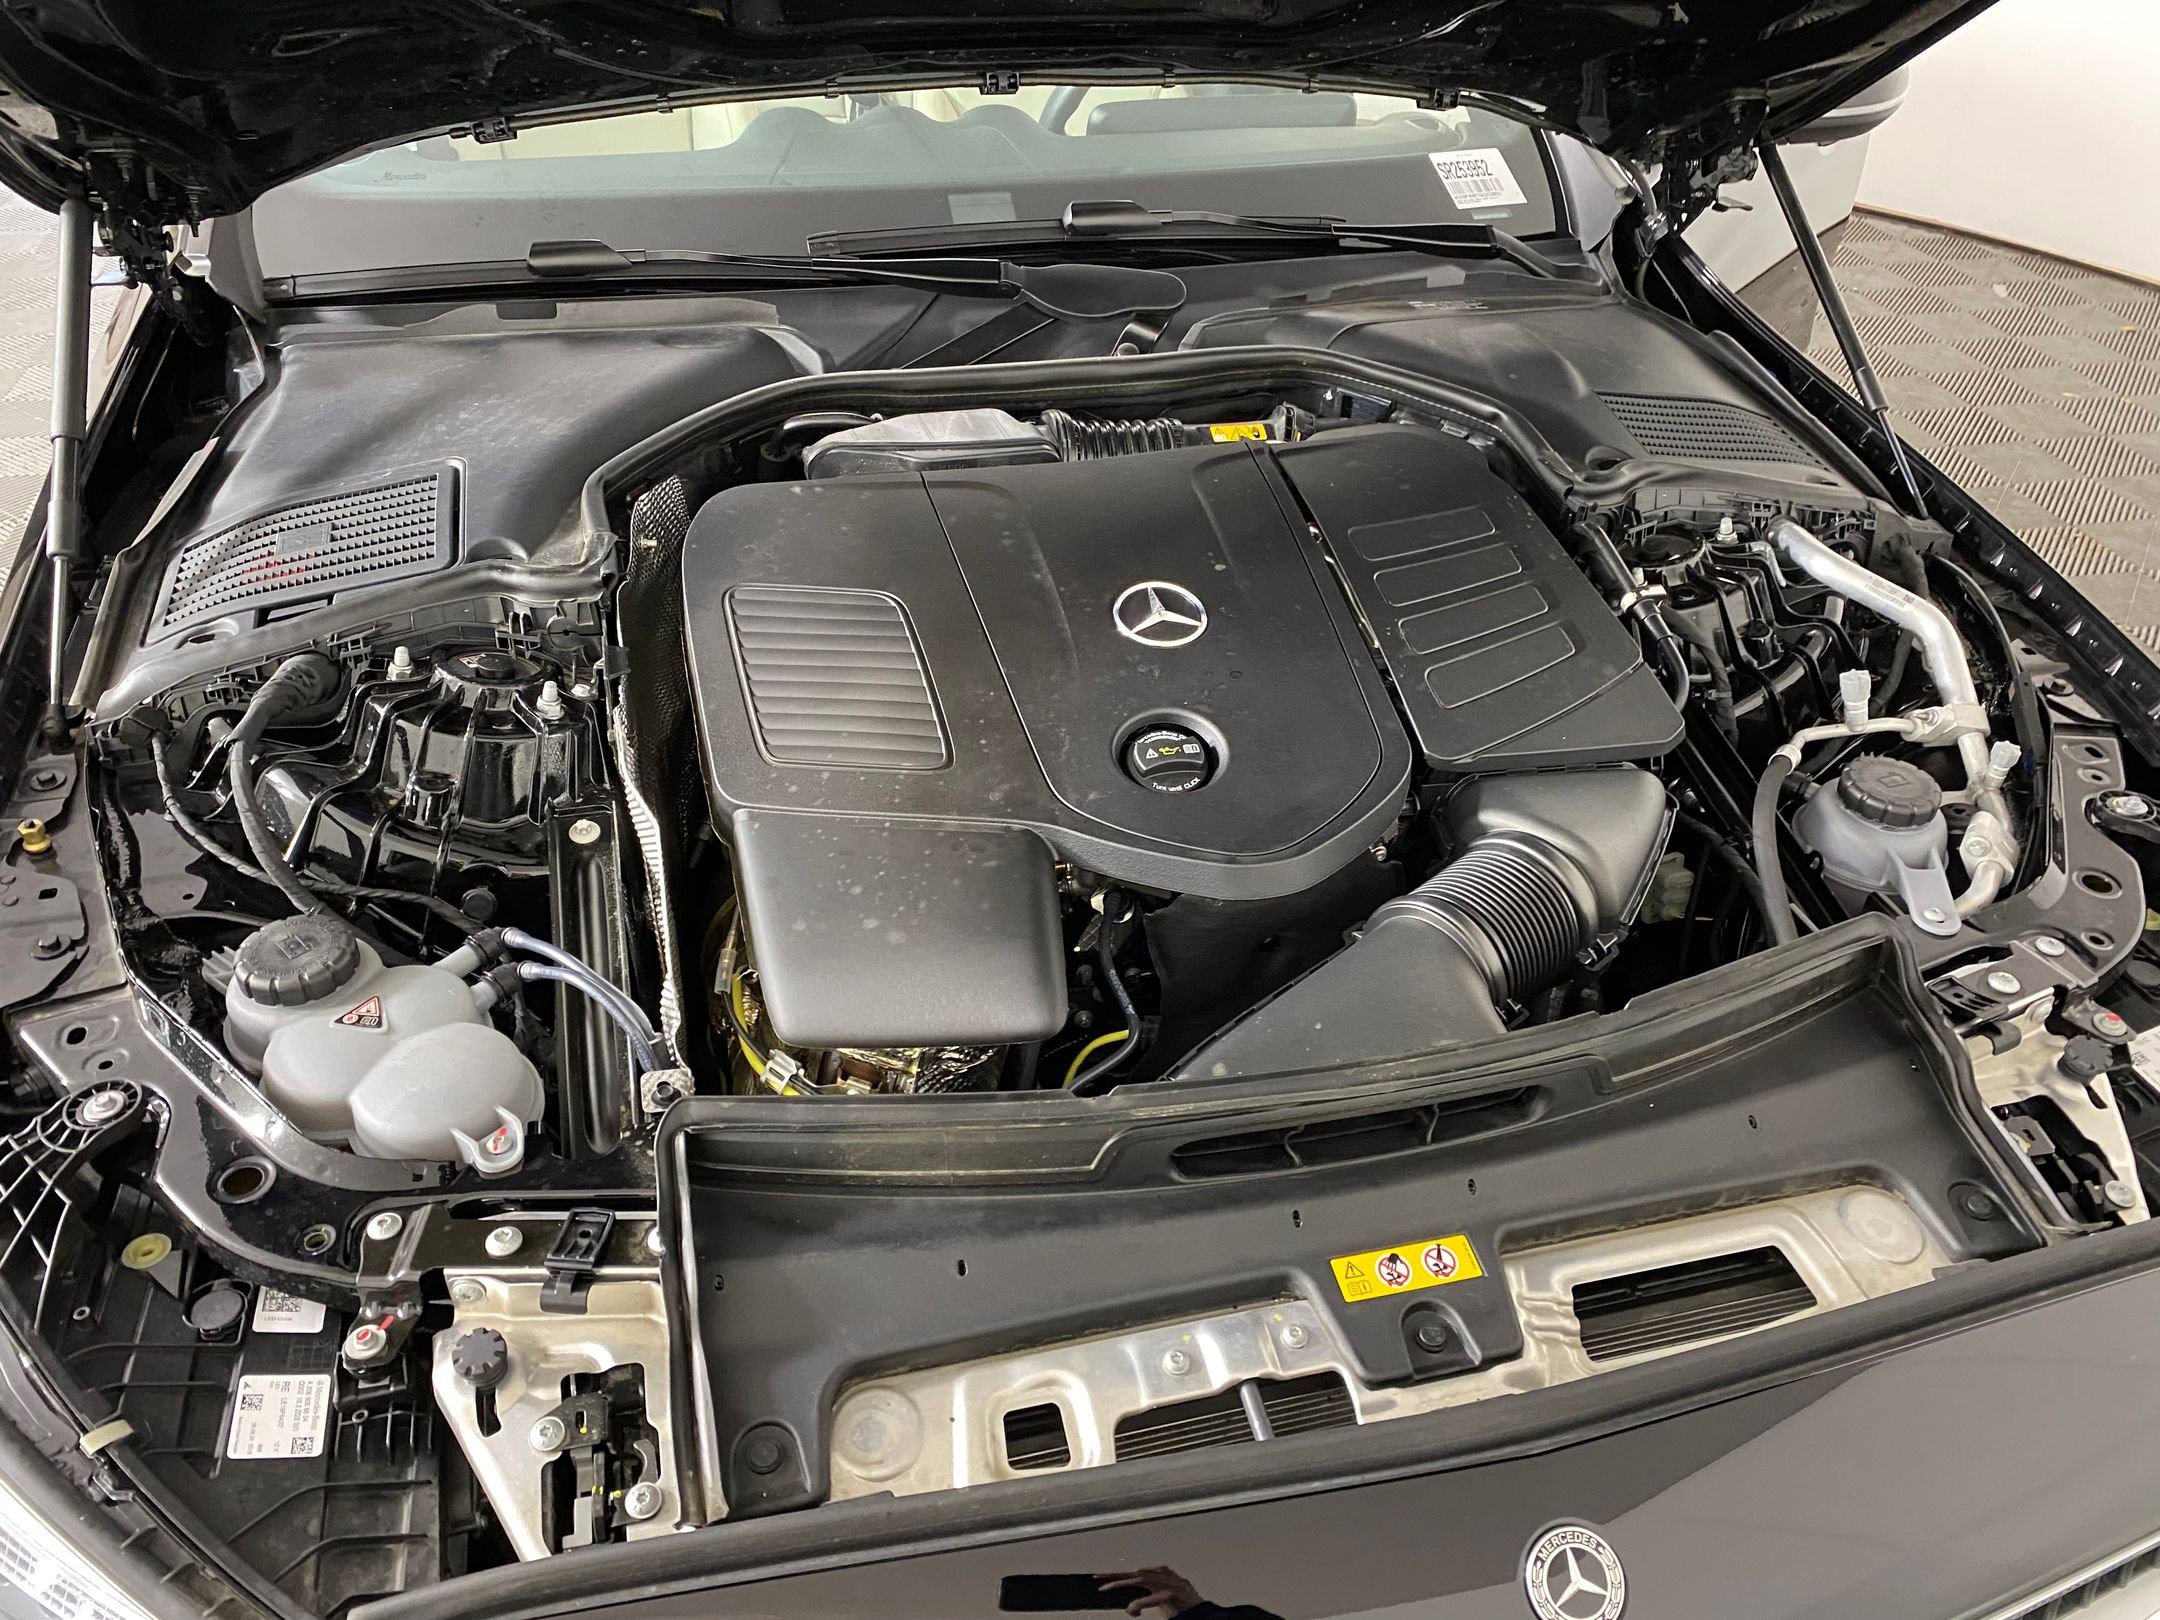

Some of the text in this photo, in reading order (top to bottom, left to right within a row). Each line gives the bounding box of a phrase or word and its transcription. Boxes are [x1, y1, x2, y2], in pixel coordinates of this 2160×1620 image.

[1437, 159, 1493, 180] SR253952
[1152, 782, 1167, 791] Turn
[1184, 777, 1201, 789] CLICK
[280, 1381, 291, 1393] RE
[1537, 1531, 1598, 1561] MERCEDES
